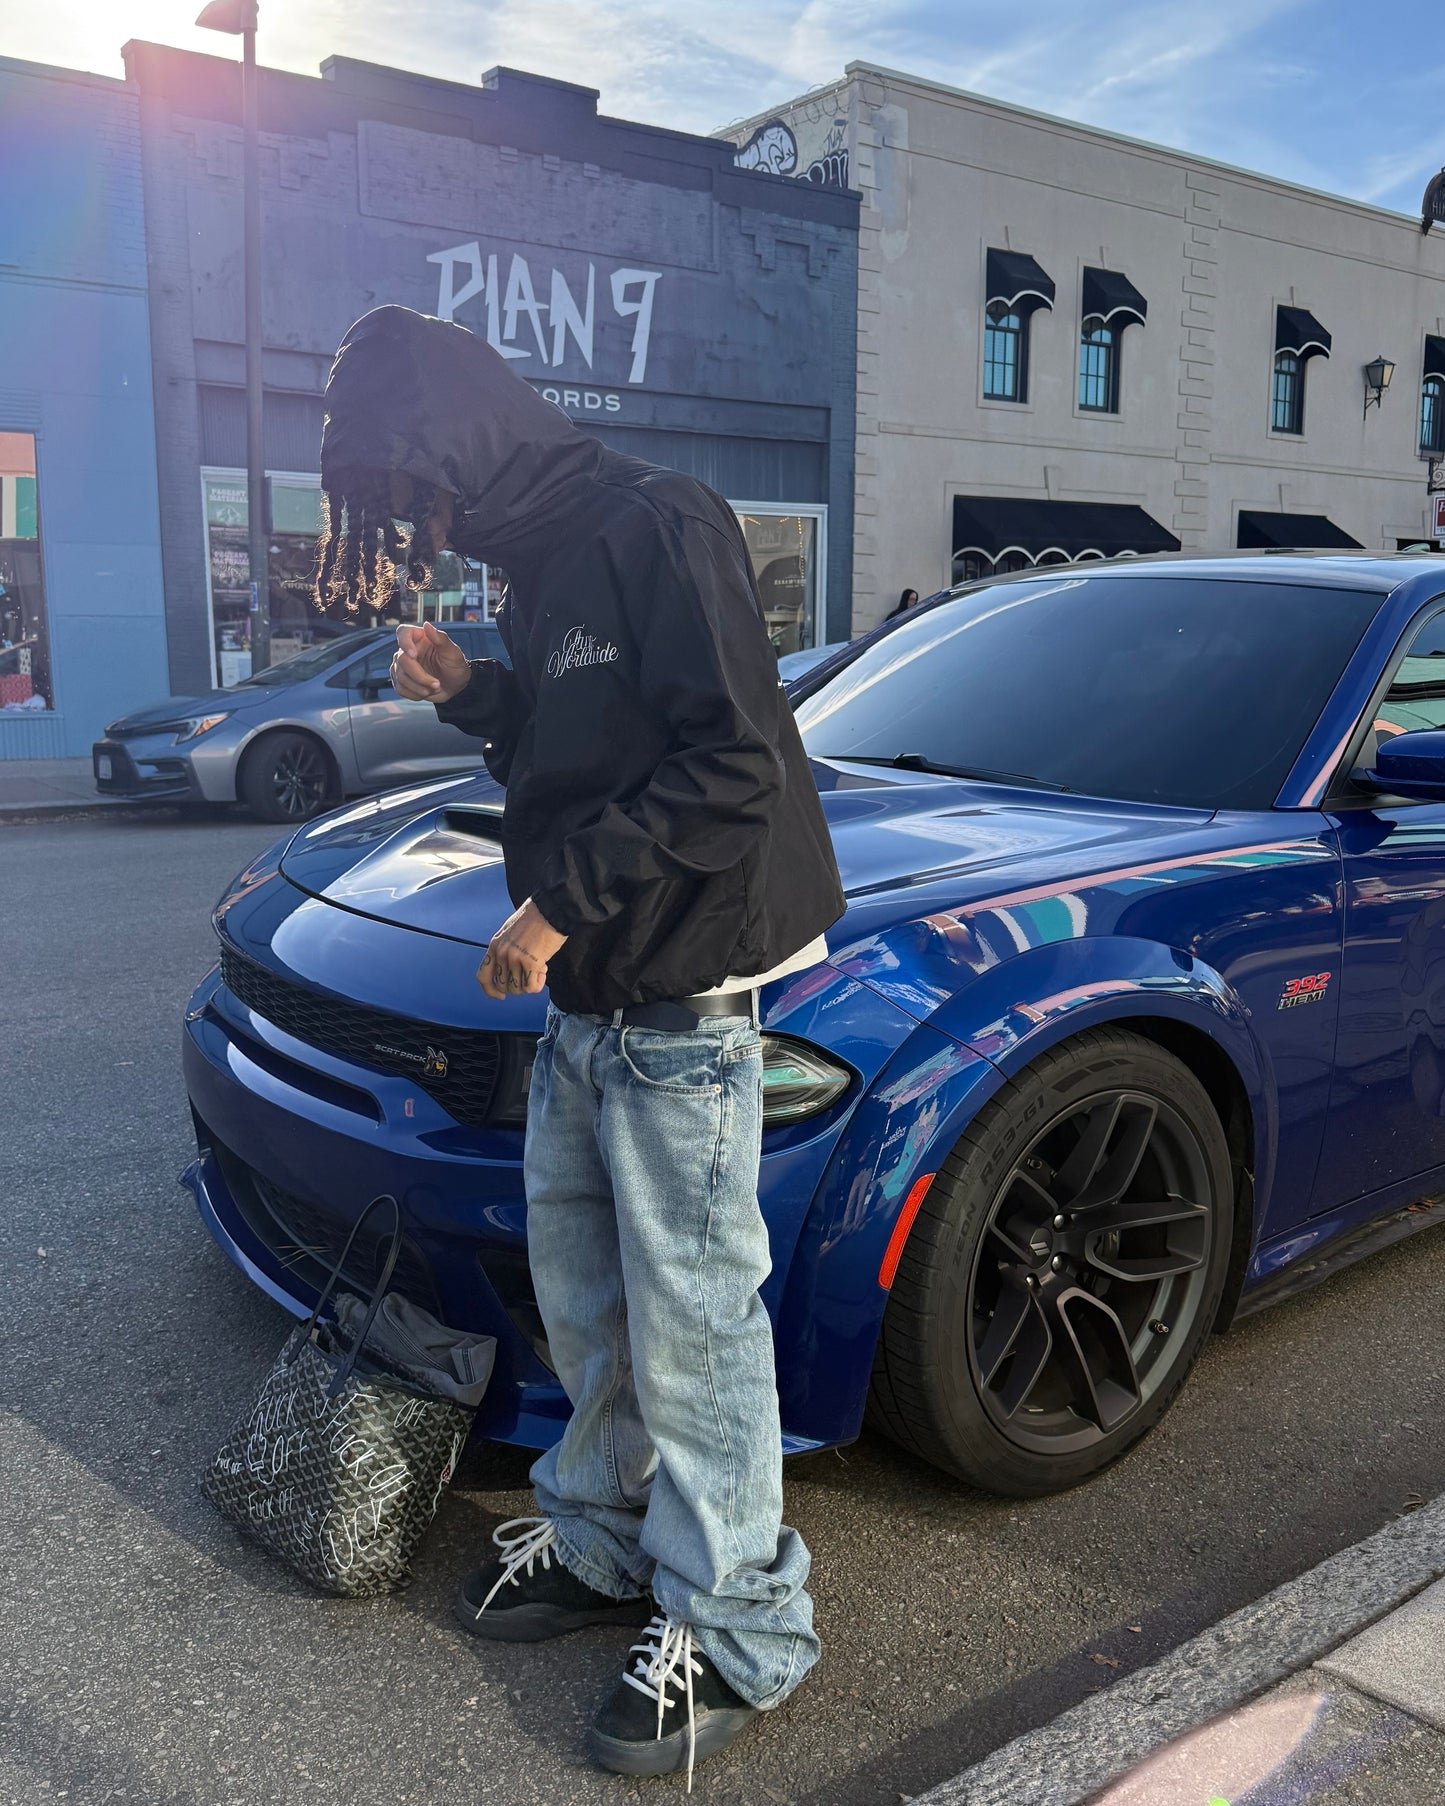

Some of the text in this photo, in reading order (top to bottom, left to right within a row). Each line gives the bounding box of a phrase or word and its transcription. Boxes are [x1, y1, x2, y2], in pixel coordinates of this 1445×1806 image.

[426, 241, 663, 383] PLAN 9
[535, 388, 621, 411] ORDS
[1278, 989, 1326, 1010] HEMI
[1282, 972, 1332, 998] 392
[394, 1398, 434, 1428] OFF
[272, 1428, 310, 1474] OFF
[249, 1486, 296, 1519] FUCK OFF
